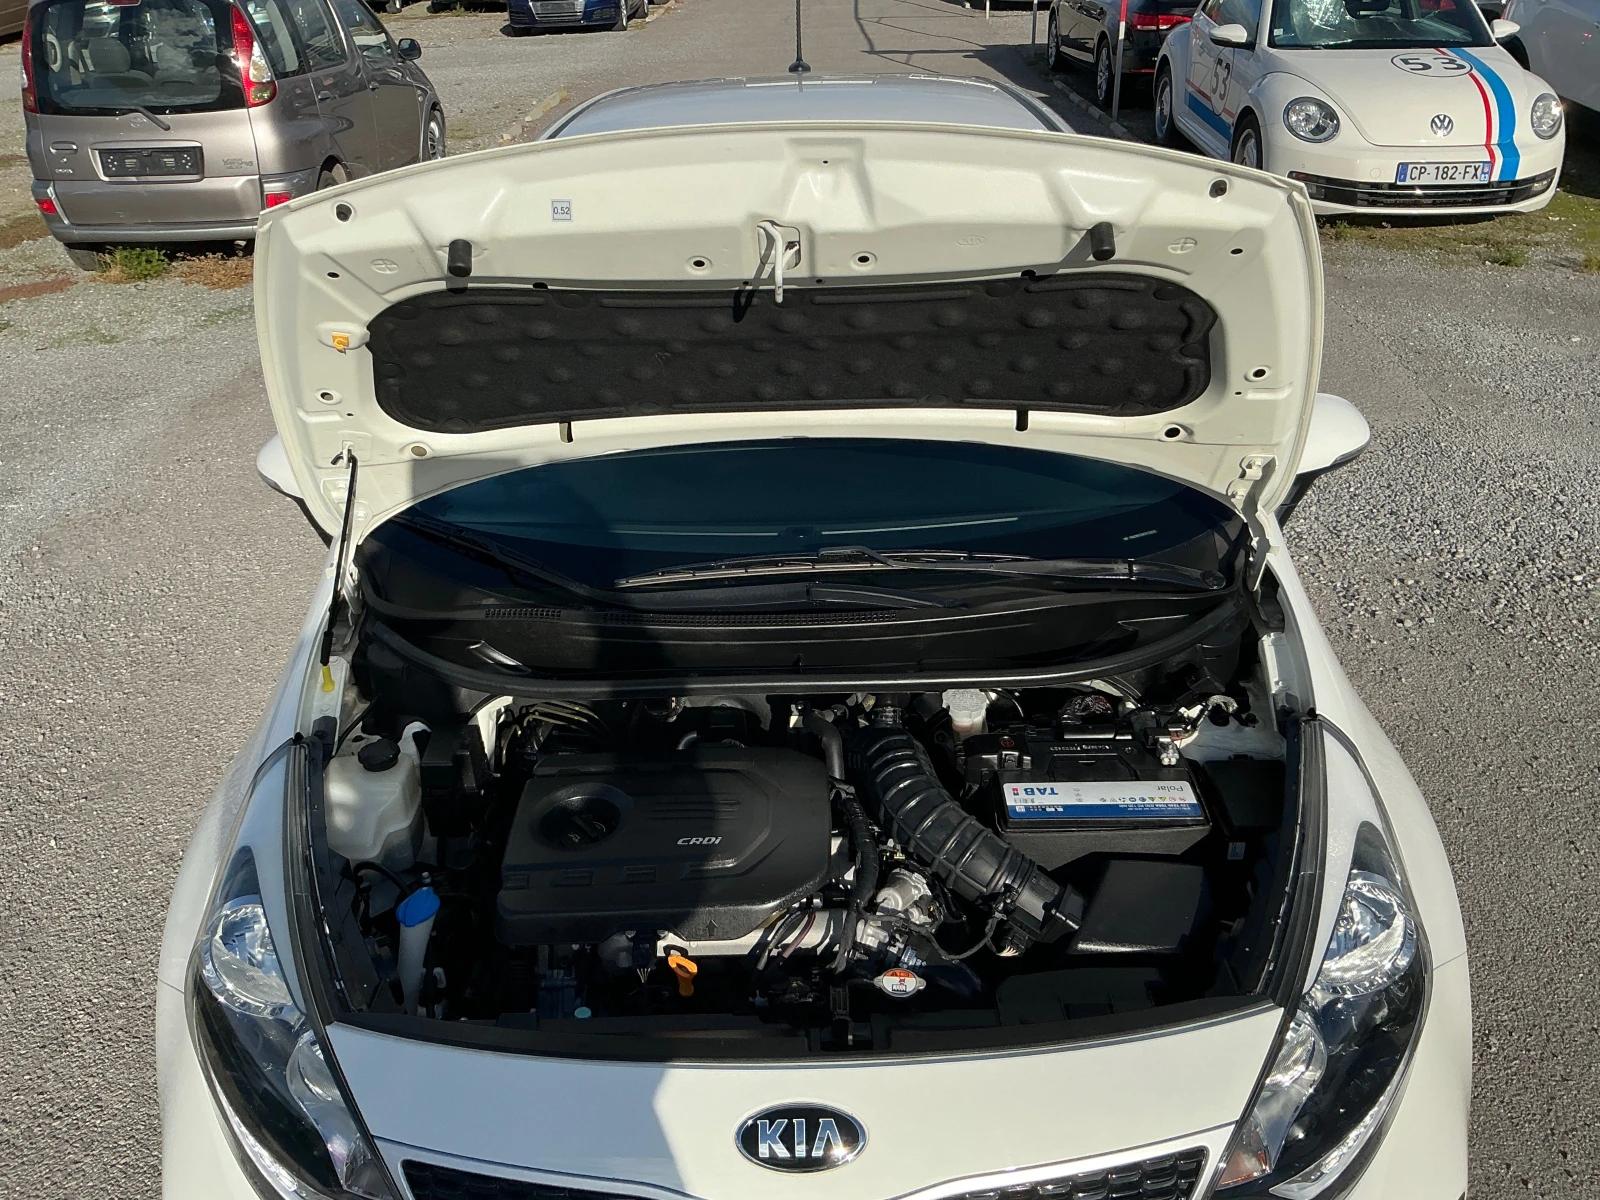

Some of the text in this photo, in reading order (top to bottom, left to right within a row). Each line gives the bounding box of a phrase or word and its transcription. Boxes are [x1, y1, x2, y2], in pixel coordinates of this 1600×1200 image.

[1399, 57, 1466, 71] 53
[1211, 57, 1231, 101] 53
[1409, 164, 1481, 181] CP-182-FX
[553, 206, 570, 215] 0.52
[1023, 787, 1059, 796] TAB
[676, 836, 722, 845] CRDi
[756, 1118, 848, 1158] KIA
